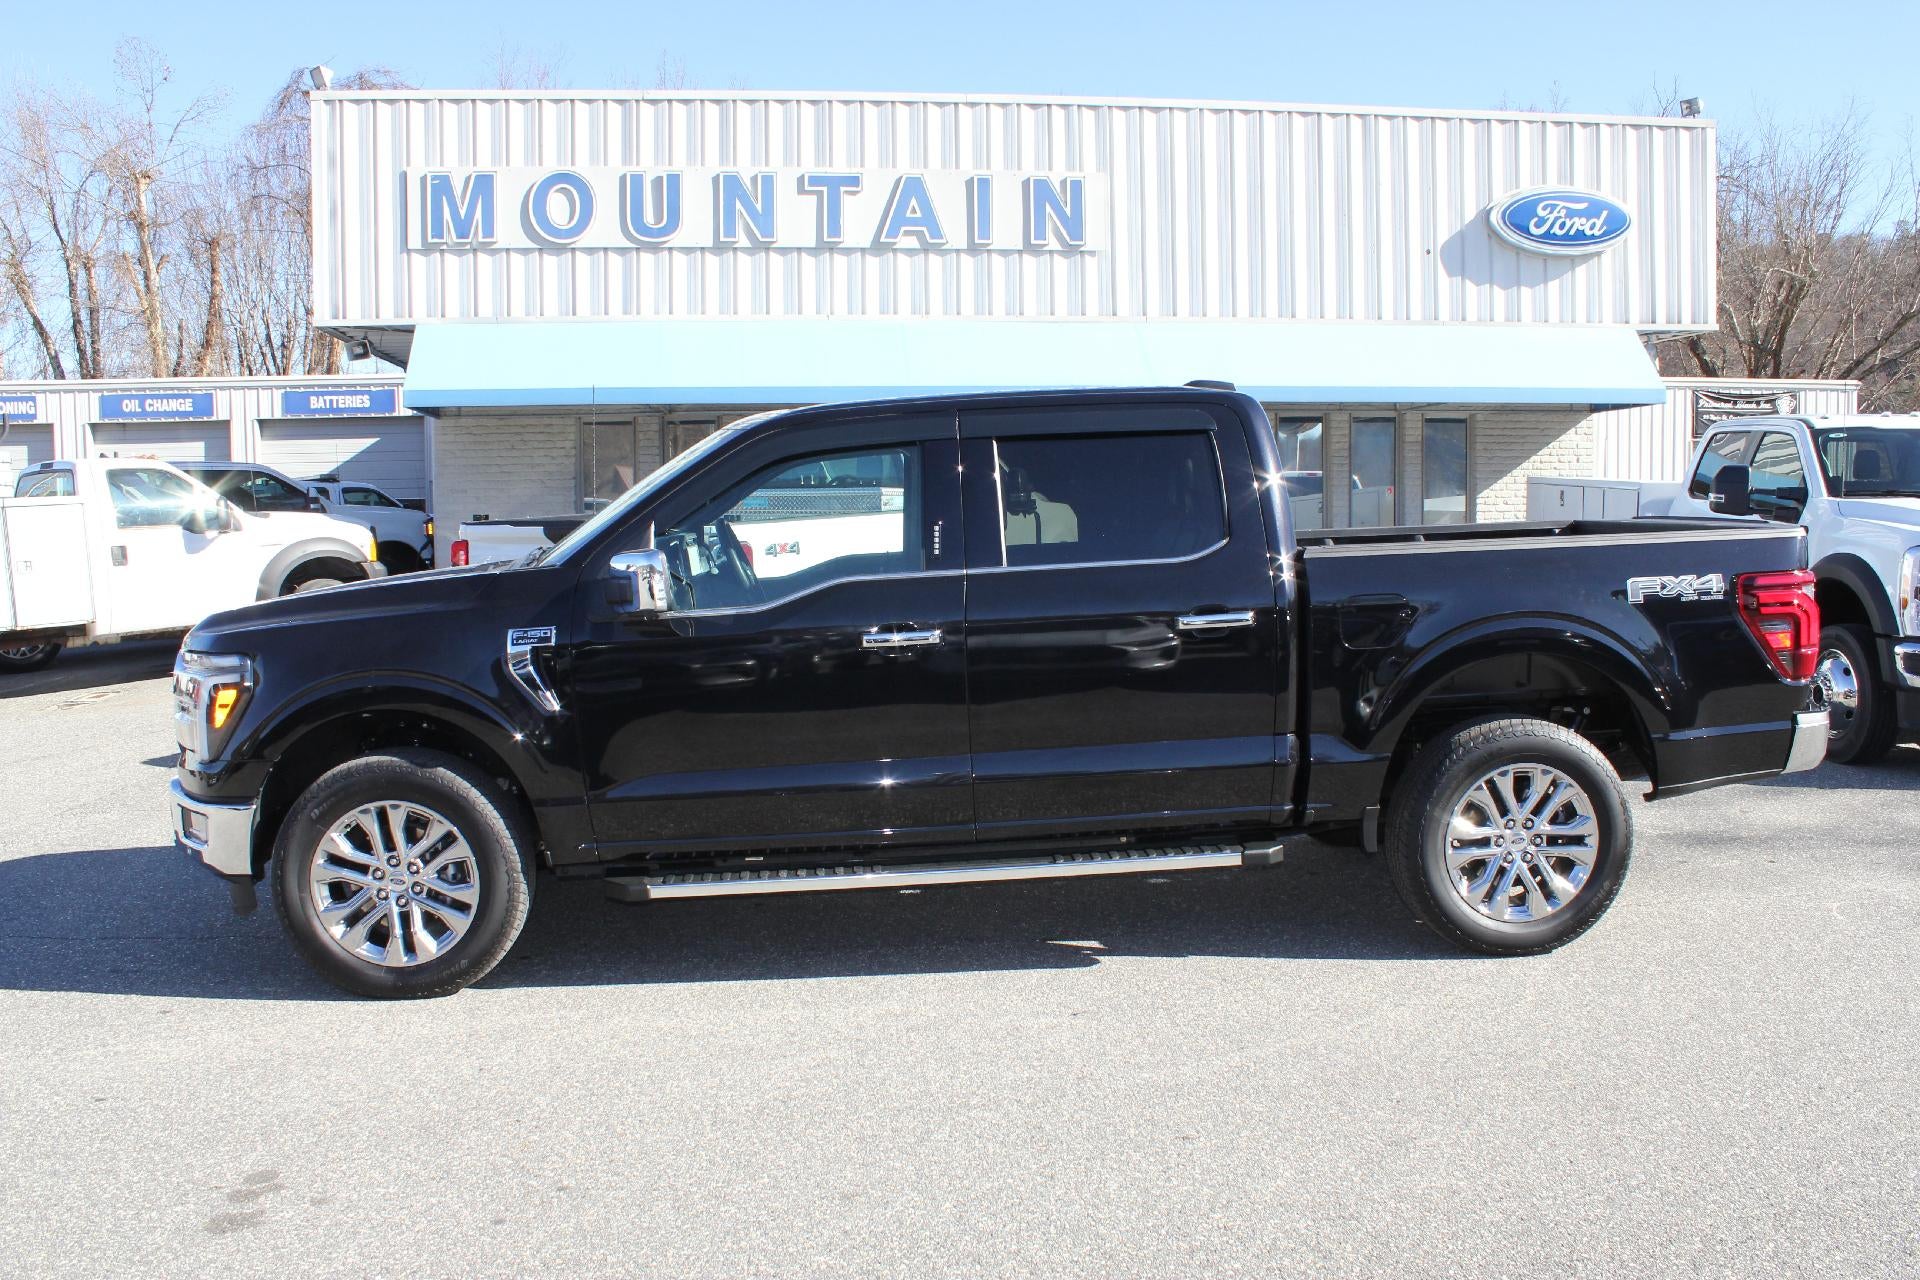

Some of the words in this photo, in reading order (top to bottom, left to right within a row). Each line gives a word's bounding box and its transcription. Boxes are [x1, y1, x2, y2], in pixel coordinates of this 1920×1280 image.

[426, 170, 1086, 246] MOUNTAIN
[1528, 200, 1609, 237] Ford
[122, 399, 142, 413] OIL
[145, 398, 193, 413] CHANGE
[309, 394, 371, 409] BATTERIES
[1626, 573, 1725, 604] FX4
[513, 630, 551, 639] F-150
